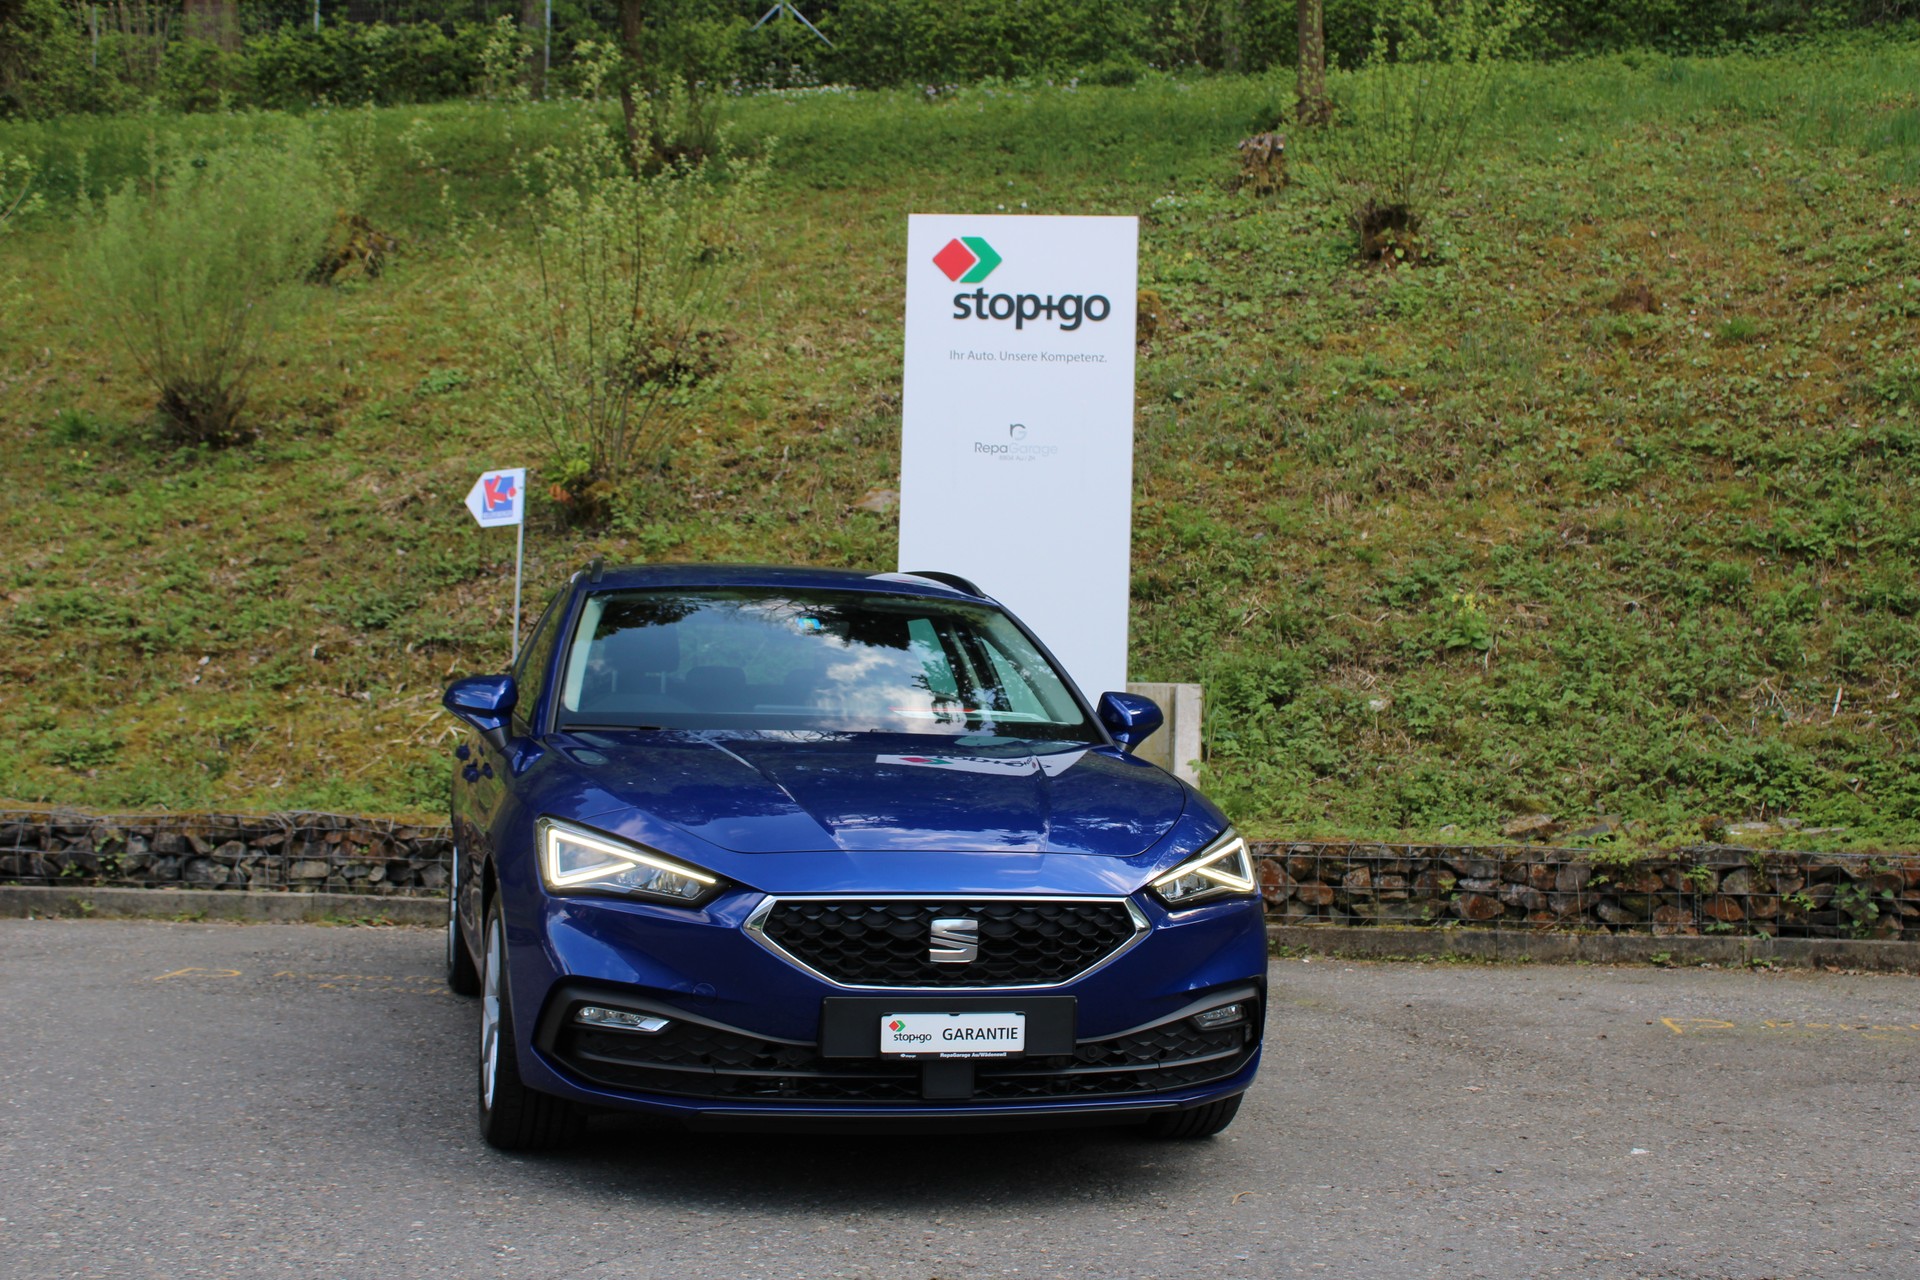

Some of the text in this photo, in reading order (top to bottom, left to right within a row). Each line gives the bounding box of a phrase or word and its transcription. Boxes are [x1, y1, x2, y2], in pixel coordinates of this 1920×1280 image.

[953, 287, 1111, 331] stop+go
[950, 351, 1107, 364] Ihr Auto. Unsere Kompetenz.
[893, 1027, 1018, 1043] stop+go GARANTIE
